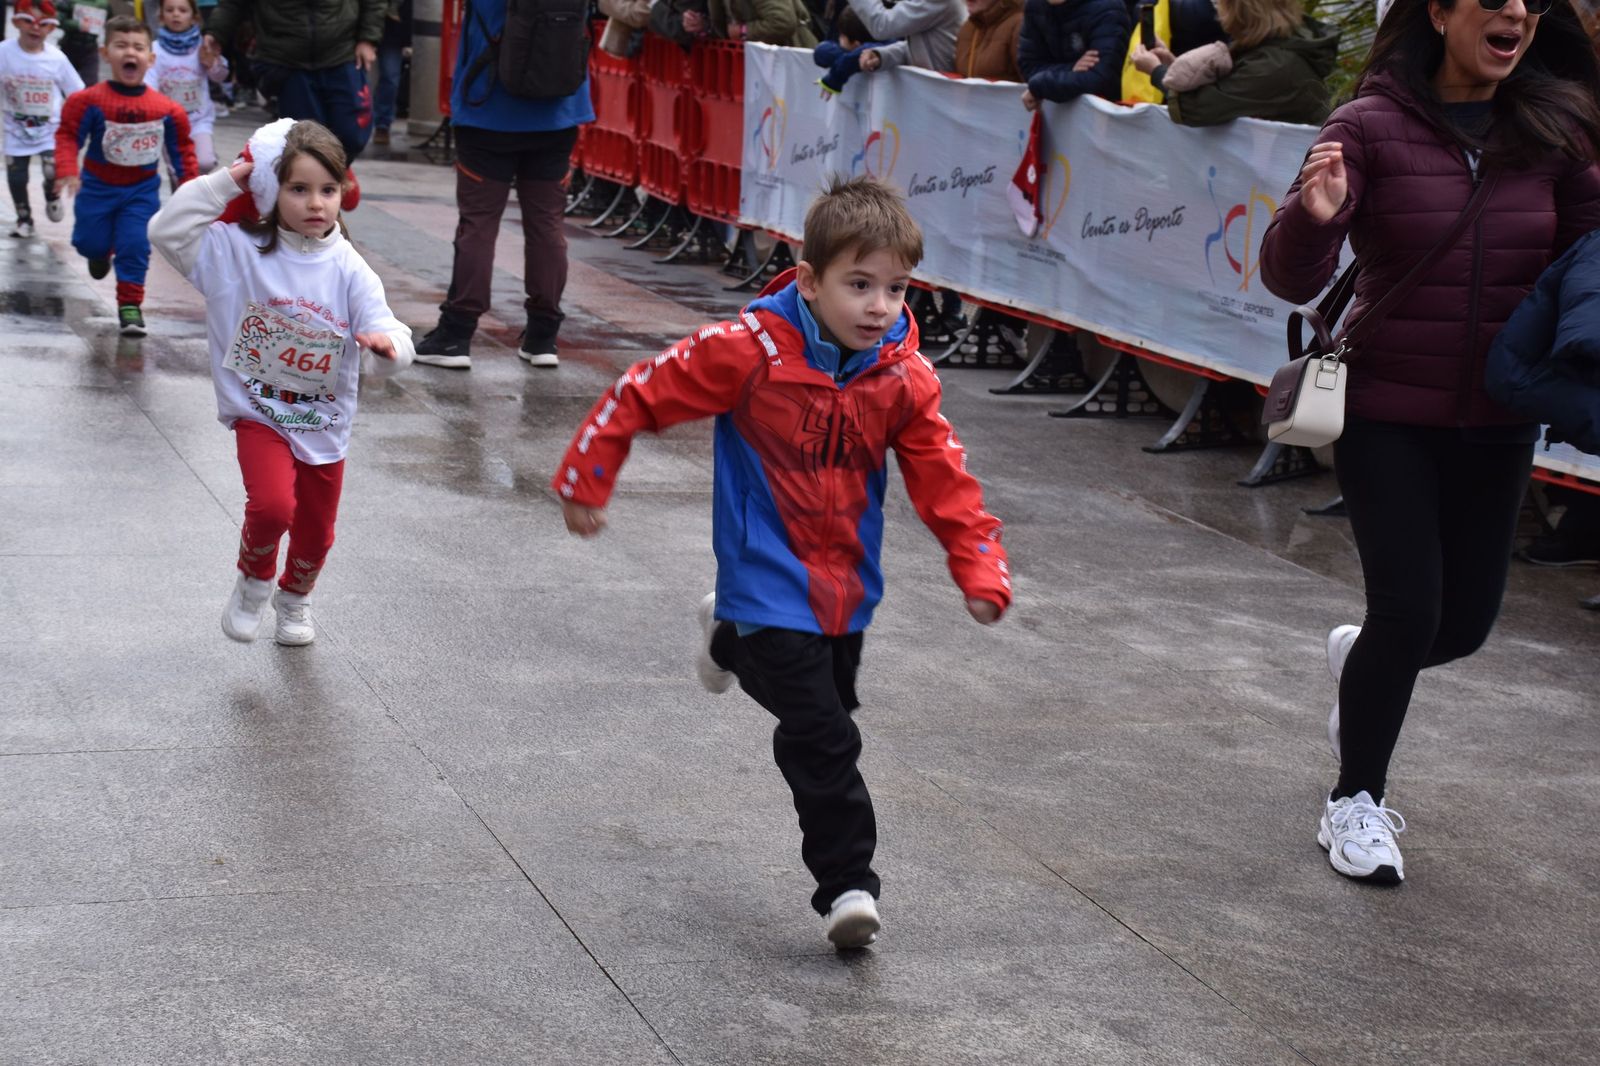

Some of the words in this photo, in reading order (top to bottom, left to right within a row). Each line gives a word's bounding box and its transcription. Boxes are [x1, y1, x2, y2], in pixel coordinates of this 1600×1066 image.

[24, 91, 50, 104] 108
[950, 166, 997, 199] Deporte
[1081, 211, 1117, 239] Ceuta
[1118, 219, 1131, 234] es
[1134, 205, 1186, 242] Deporte
[278, 347, 332, 374] 464
[261, 404, 322, 426] Daniella
